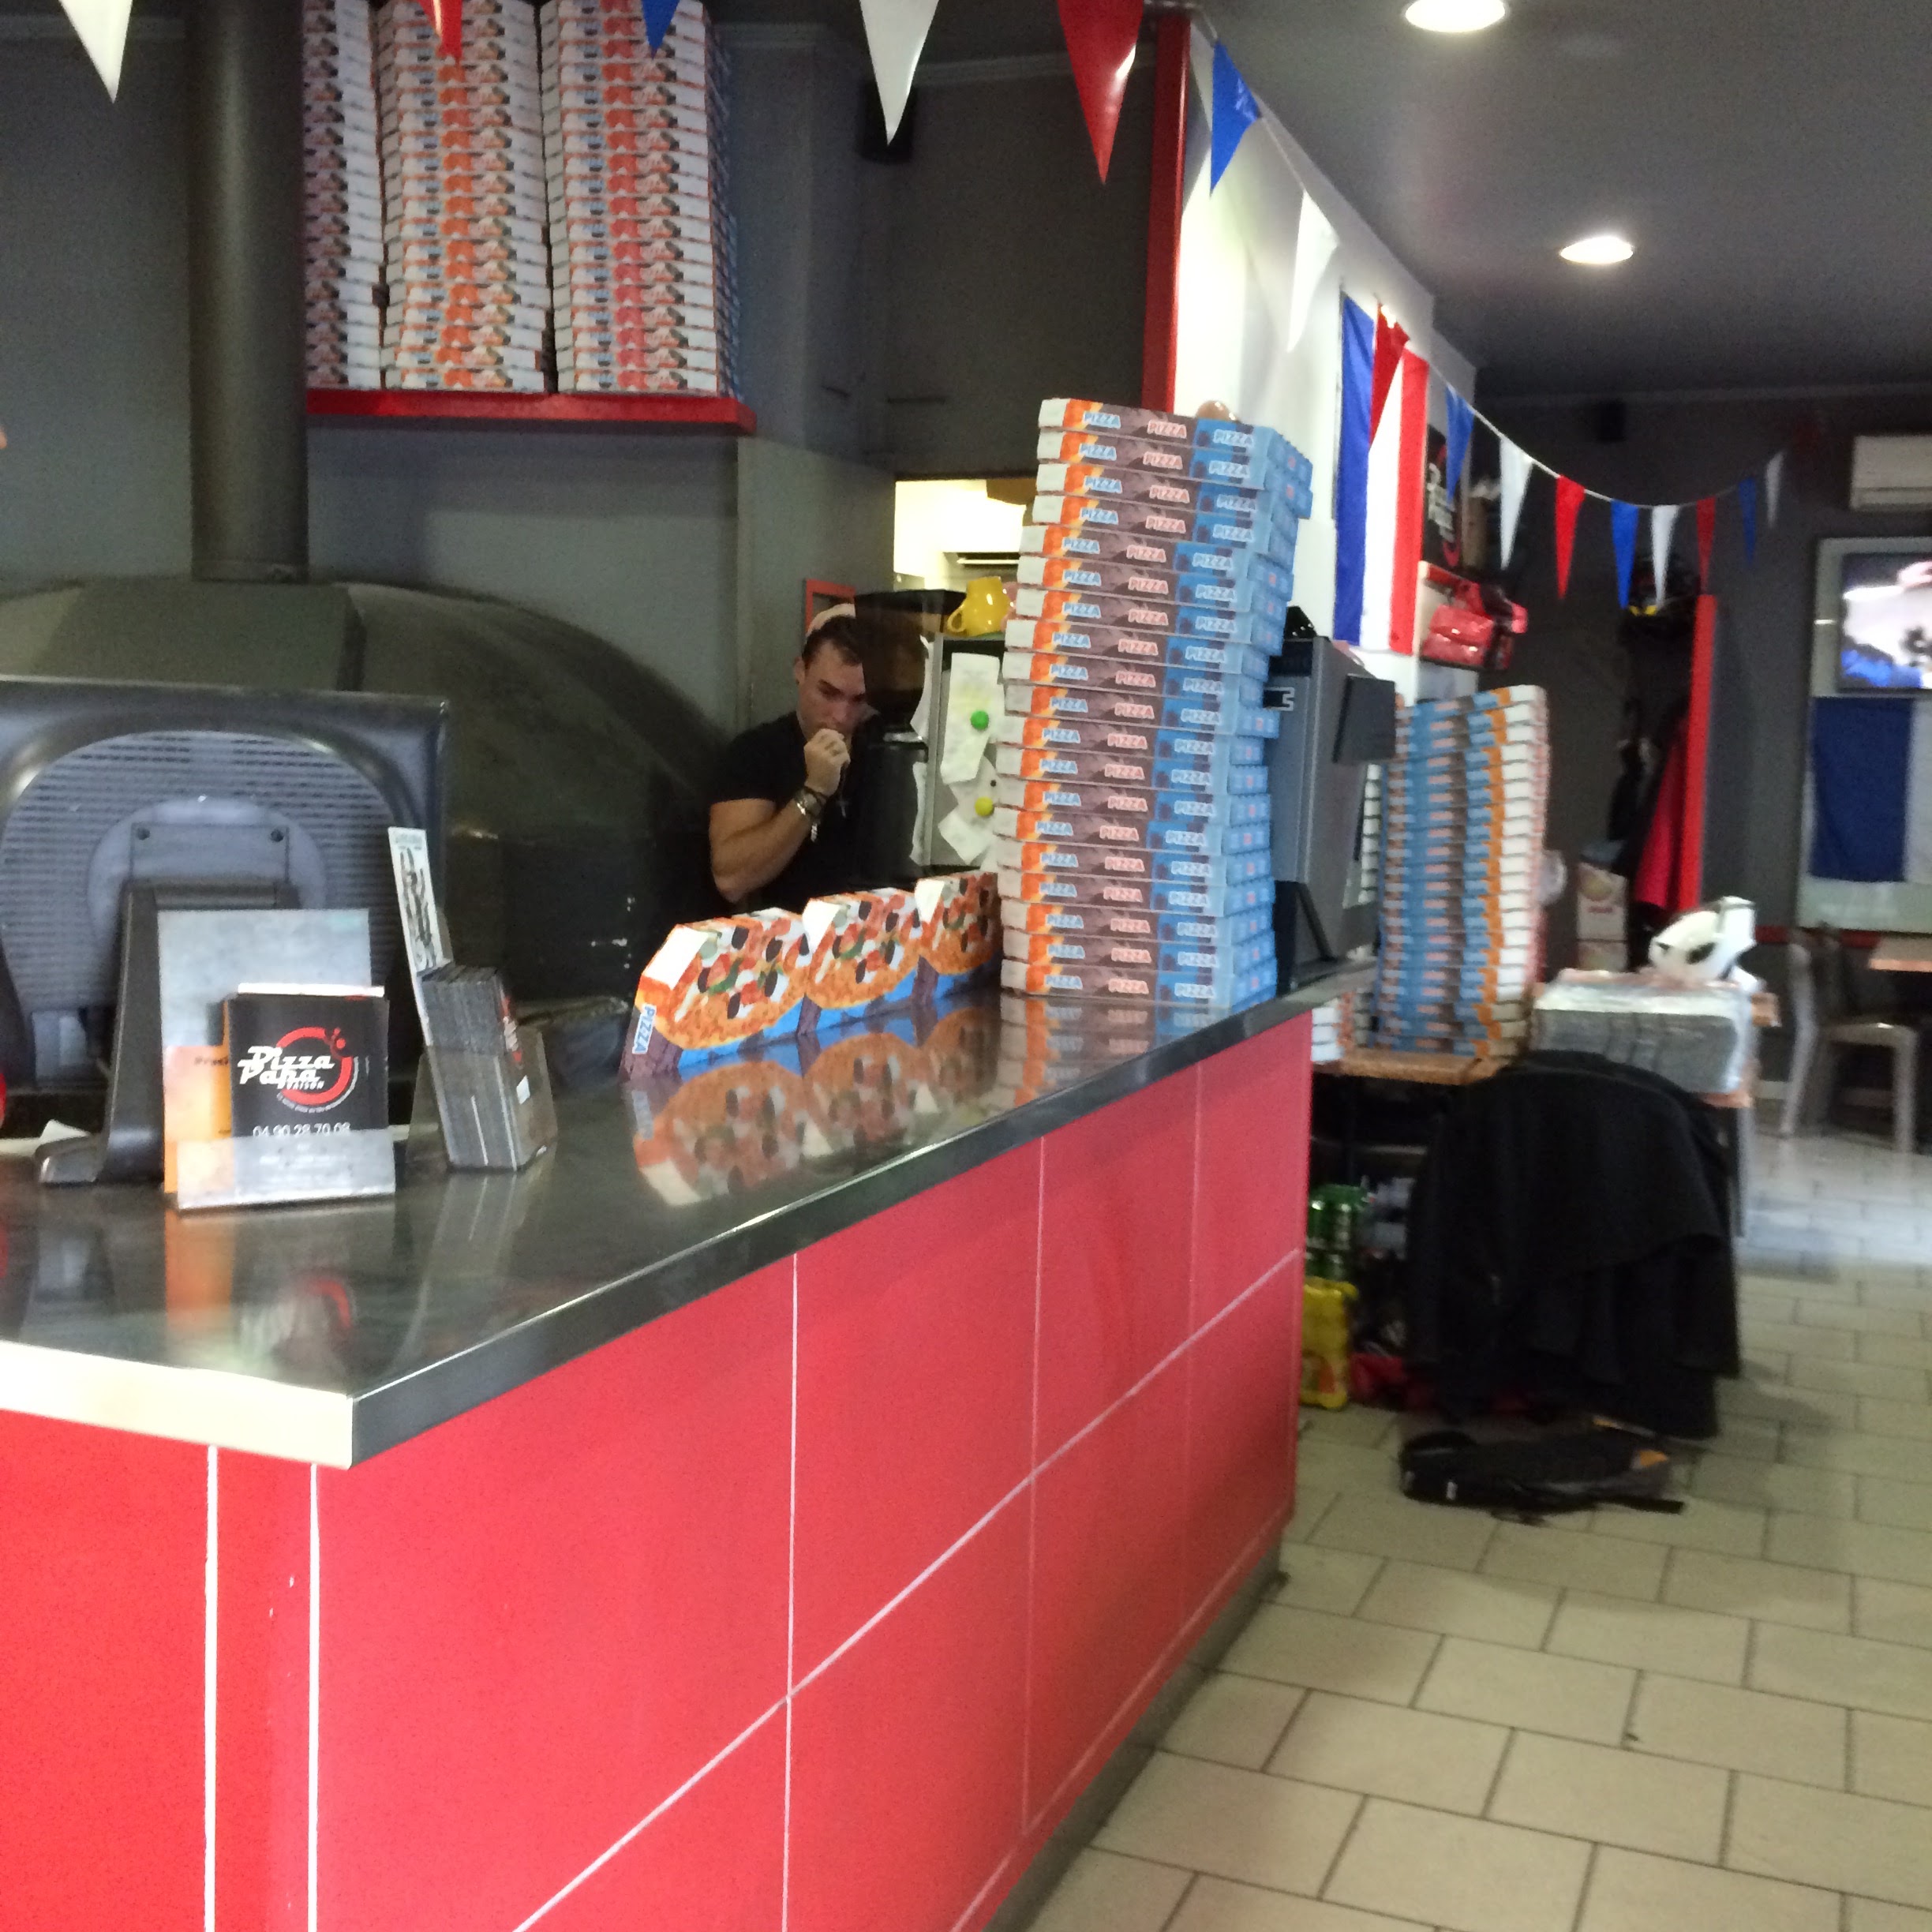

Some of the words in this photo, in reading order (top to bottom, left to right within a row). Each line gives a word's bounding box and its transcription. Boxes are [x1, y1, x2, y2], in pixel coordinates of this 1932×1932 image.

[1084, 412, 1121, 429] PIZZA
[1148, 420, 1186, 437] PIZZA
[1214, 429, 1254, 447] PIZZA
[1080, 444, 1117, 460] PIZZA
[1143, 452, 1182, 470] PIZZA
[1209, 461, 1250, 478] PIZZA
[1084, 477, 1122, 493] PIZZA
[1149, 485, 1189, 503] PIZZA
[1217, 495, 1256, 511] PIZZA
[1080, 508, 1118, 525] PIZZA
[1145, 516, 1186, 534] PIZZA
[1212, 524, 1254, 542] PIZZA
[1062, 538, 1100, 554] PIZZA
[1127, 545, 1166, 563] PIZZA
[1193, 553, 1233, 570] PIZZA
[1063, 571, 1101, 586] PIZZA
[1129, 577, 1168, 594] PIZZA
[1196, 585, 1237, 601] PIZZA
[1063, 603, 1101, 618] PIZZA
[1128, 609, 1168, 626] PIZZA
[1196, 616, 1237, 633] PIZZA
[1052, 633, 1091, 648] PIZZA
[1118, 639, 1158, 656] PIZZA
[1185, 646, 1226, 663] PIZZA
[1050, 665, 1088, 680] PIZZA
[1116, 672, 1155, 687] PIZZA
[1183, 679, 1223, 695] PIZZA
[1050, 698, 1088, 713] PIZZA
[1115, 703, 1155, 720] PIZZA
[1181, 709, 1222, 724] PIZZA
[1043, 728, 1080, 743] PIZZA
[1107, 734, 1148, 750] PIZZA
[1174, 739, 1215, 754] PIZZA
[1039, 759, 1077, 774] PIZZA
[1104, 764, 1144, 780] PIZZA
[1171, 769, 1211, 785] PIZZA
[1043, 792, 1081, 806] PIZZA
[1108, 796, 1148, 812] PIZZA
[1174, 801, 1215, 817] PIZZA
[1035, 822, 1073, 836] PIZZA
[1099, 826, 1139, 841] PIZZA
[1166, 830, 1206, 845] PIZZA
[1040, 853, 1078, 868] PIZZA
[1105, 857, 1144, 872] PIZZA
[1171, 862, 1211, 877] PIZZA
[1039, 883, 1077, 897] PIZZA
[1103, 887, 1143, 902] PIZZA
[1168, 892, 1208, 907] PIZZA
[1046, 915, 1084, 929] PIZZA
[1110, 918, 1151, 934] PIZZA
[1177, 922, 1216, 938] PIZZA
[1047, 945, 1085, 960] PIZZA
[1111, 948, 1151, 964] PIZZA
[1178, 952, 1216, 967] PIZZA
[1044, 975, 1083, 990] PIZZA
[1108, 979, 1149, 994] PIZZA
[1174, 983, 1215, 998] PIZZA
[632, 1004, 657, 1054] PIZZA
[248, 1046, 335, 1071] Pizza
[238, 1059, 320, 1089] Papa
